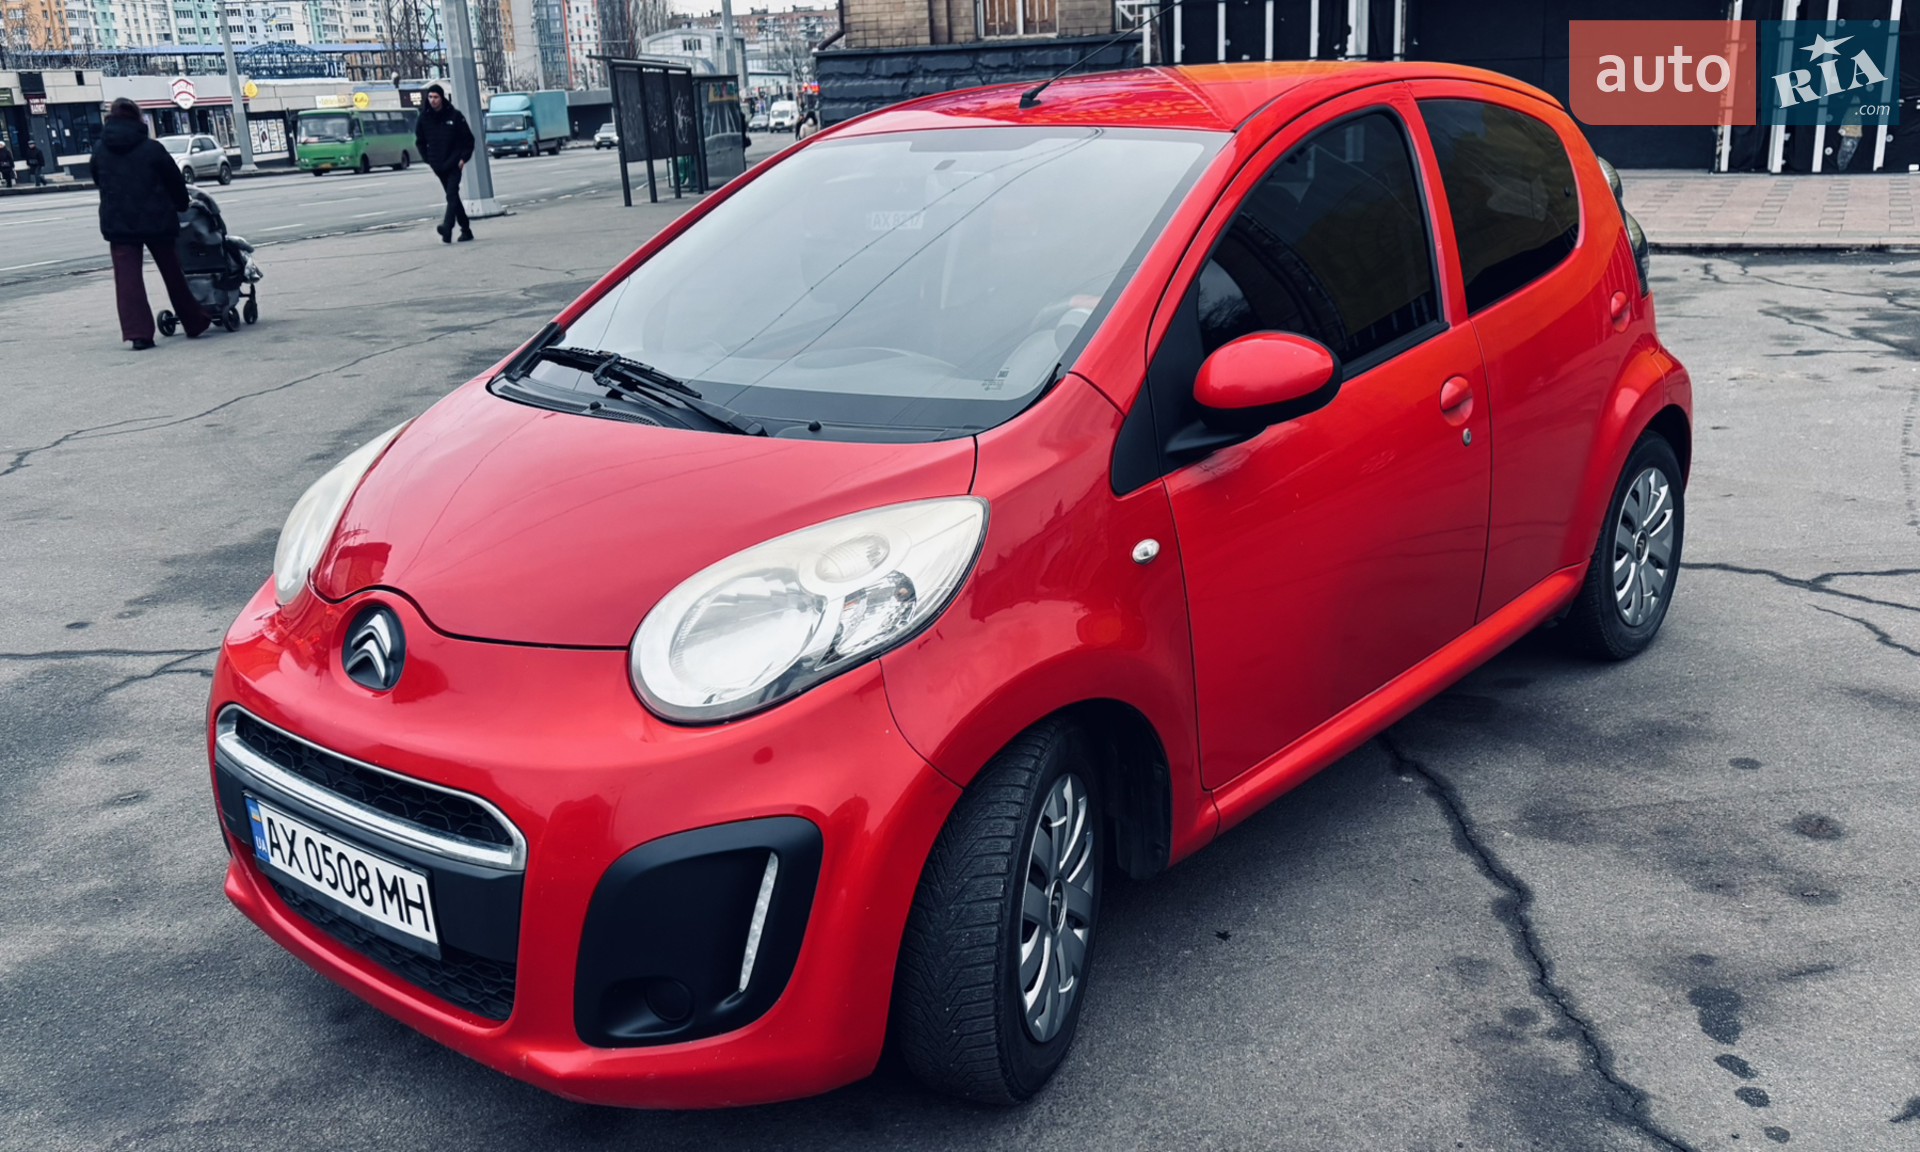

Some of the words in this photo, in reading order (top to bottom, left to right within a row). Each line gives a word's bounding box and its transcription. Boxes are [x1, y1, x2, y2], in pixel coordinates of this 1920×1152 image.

[255, 835, 268, 853] UA
[267, 816, 305, 875] AX
[304, 836, 374, 908] 0508
[375, 867, 431, 933] MH
